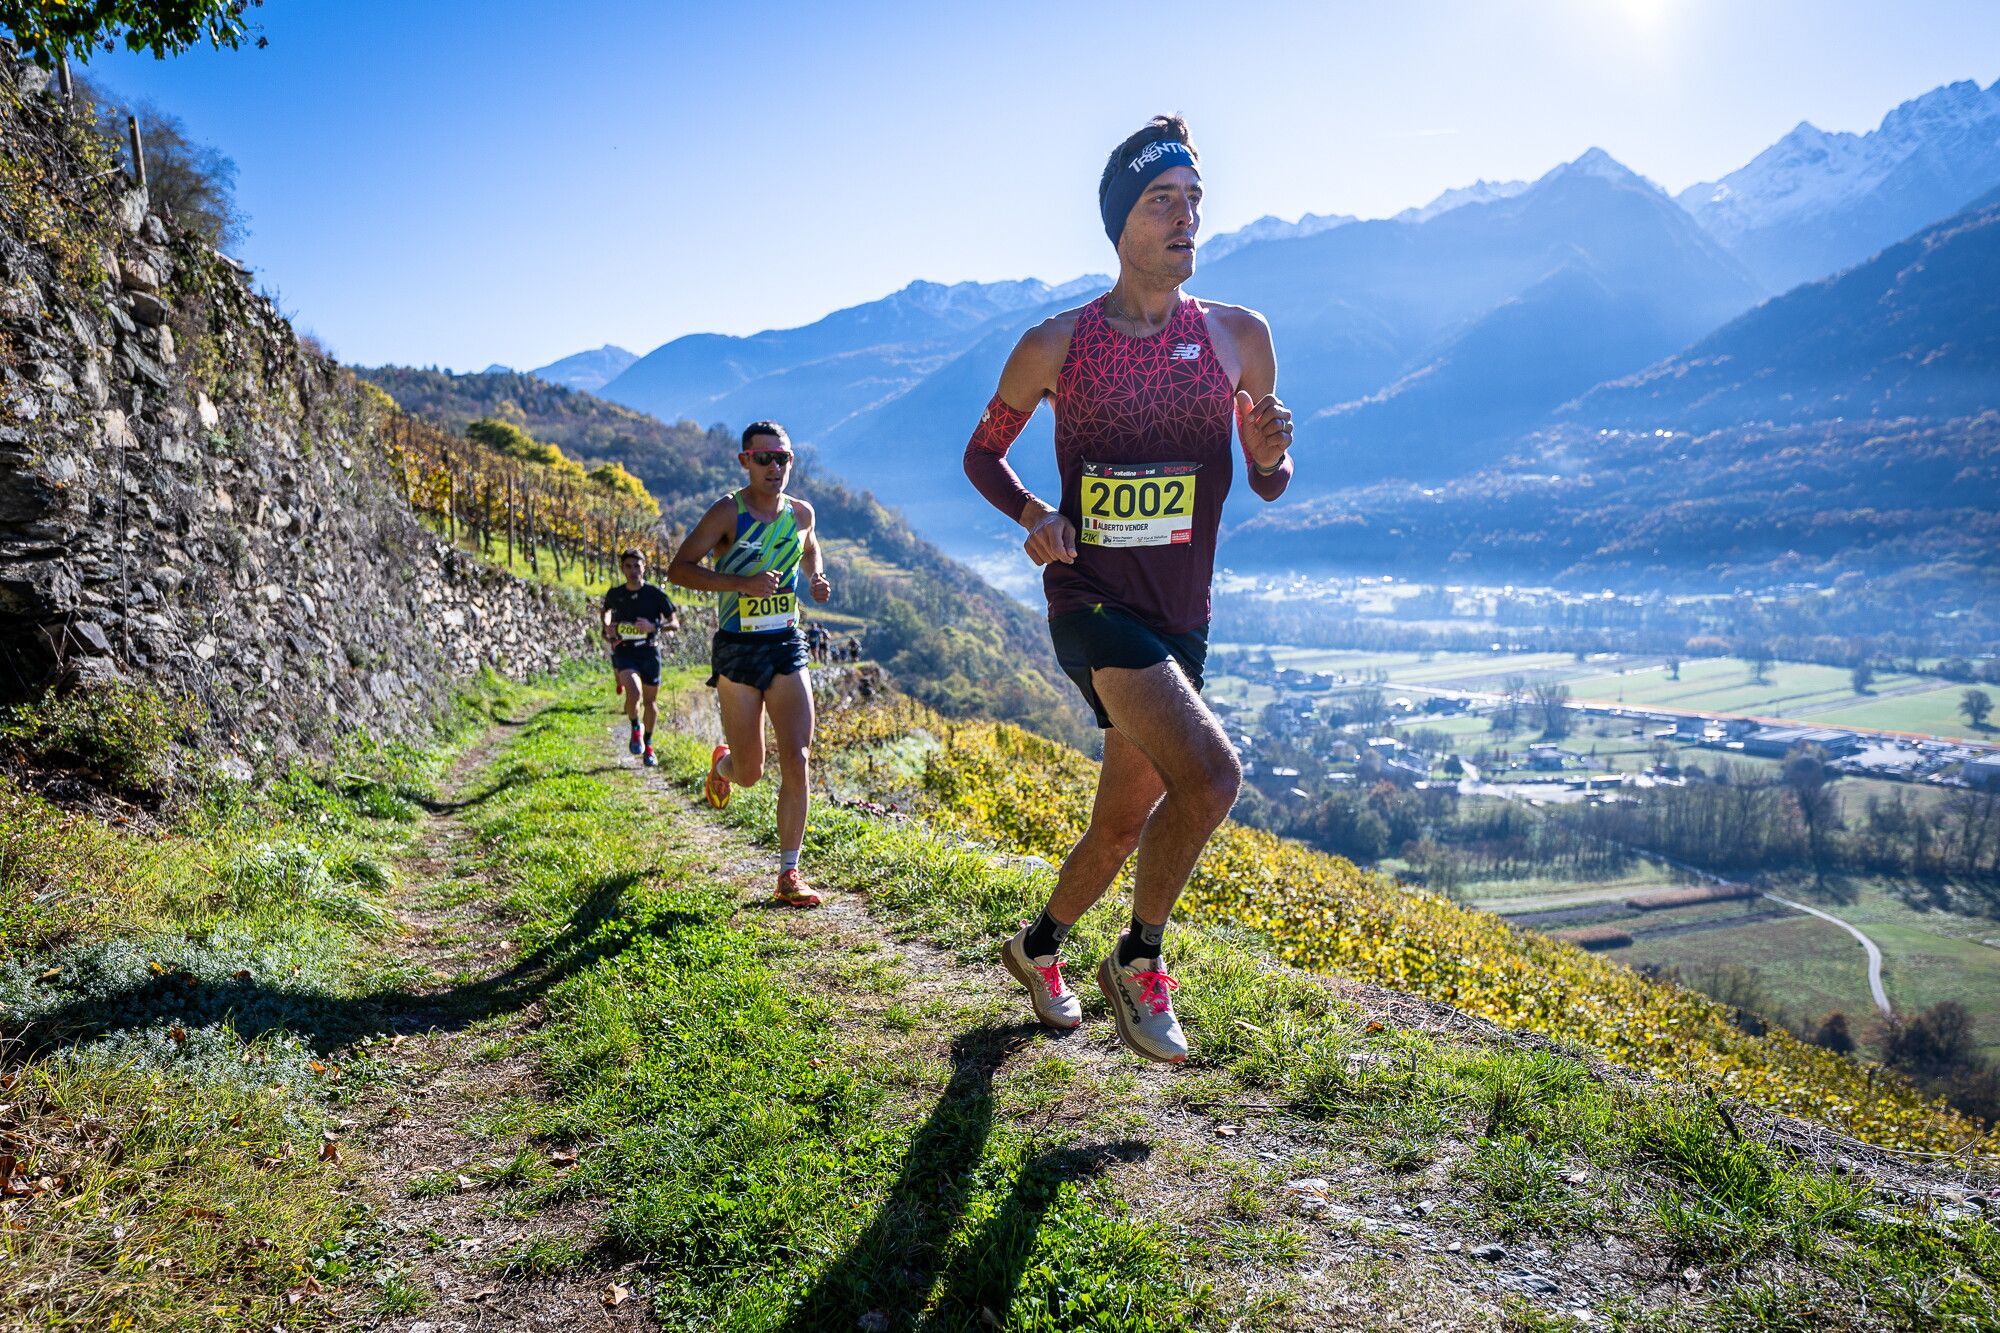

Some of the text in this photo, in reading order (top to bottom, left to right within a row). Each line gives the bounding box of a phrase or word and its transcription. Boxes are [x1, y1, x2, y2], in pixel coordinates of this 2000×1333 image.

[1090, 481, 1185, 518] 2002
[1098, 522, 1149, 532] ALBERTO VENDER
[1081, 533, 1097, 543] 21K
[747, 596, 789, 616] 2019
